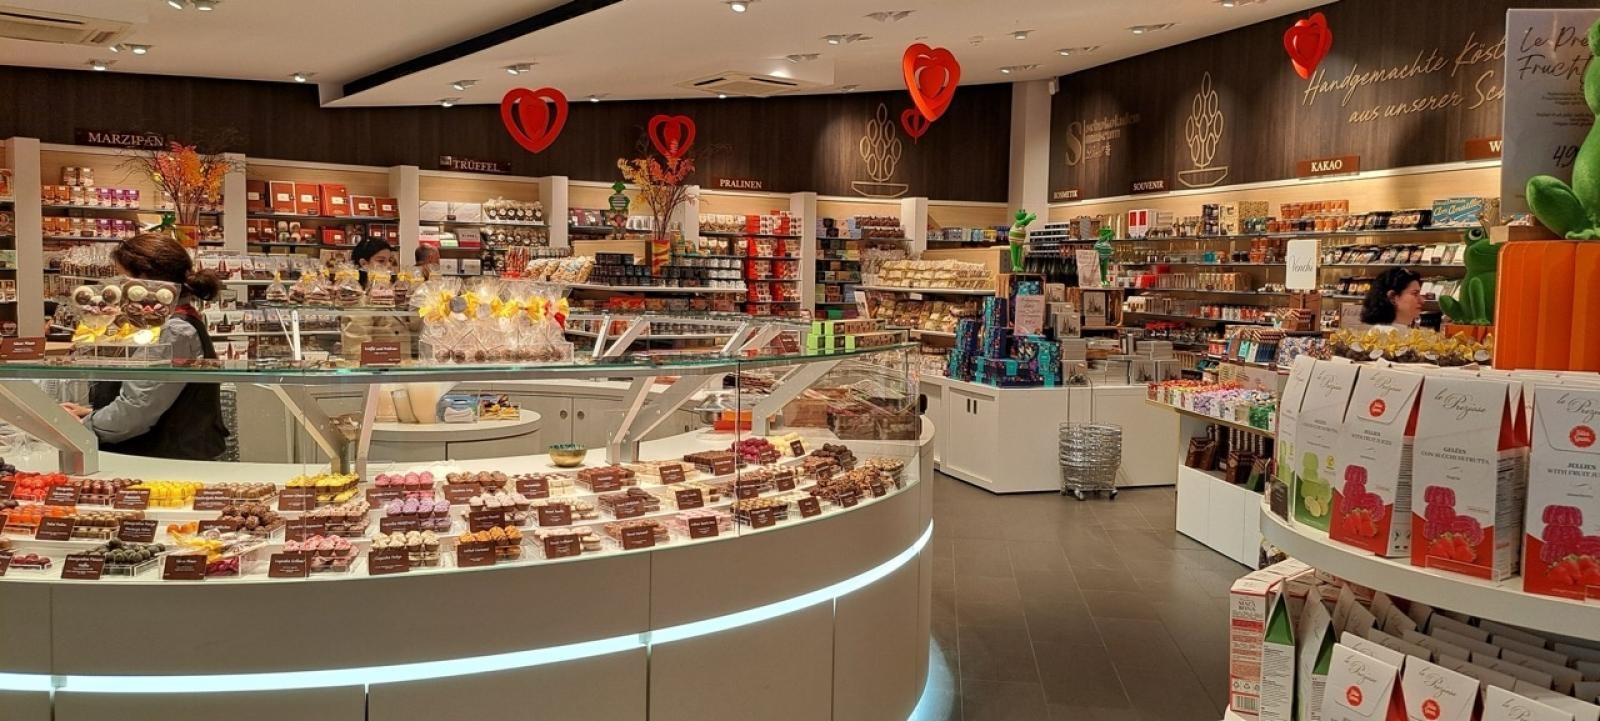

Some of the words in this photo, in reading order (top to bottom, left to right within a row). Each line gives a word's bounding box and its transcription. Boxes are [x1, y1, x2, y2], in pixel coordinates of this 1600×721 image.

[1303, 48, 1449, 108] Handgemachte
[1348, 105, 1380, 123] aus
[1384, 91, 1463, 118] unserer
[88, 131, 164, 147] MARZIPAN
[453, 158, 501, 172] TRÜFFEL
[1311, 159, 1343, 172] KAKAO
[719, 178, 763, 189] PRALINEN
[1133, 180, 1164, 191] SOUVENIR
